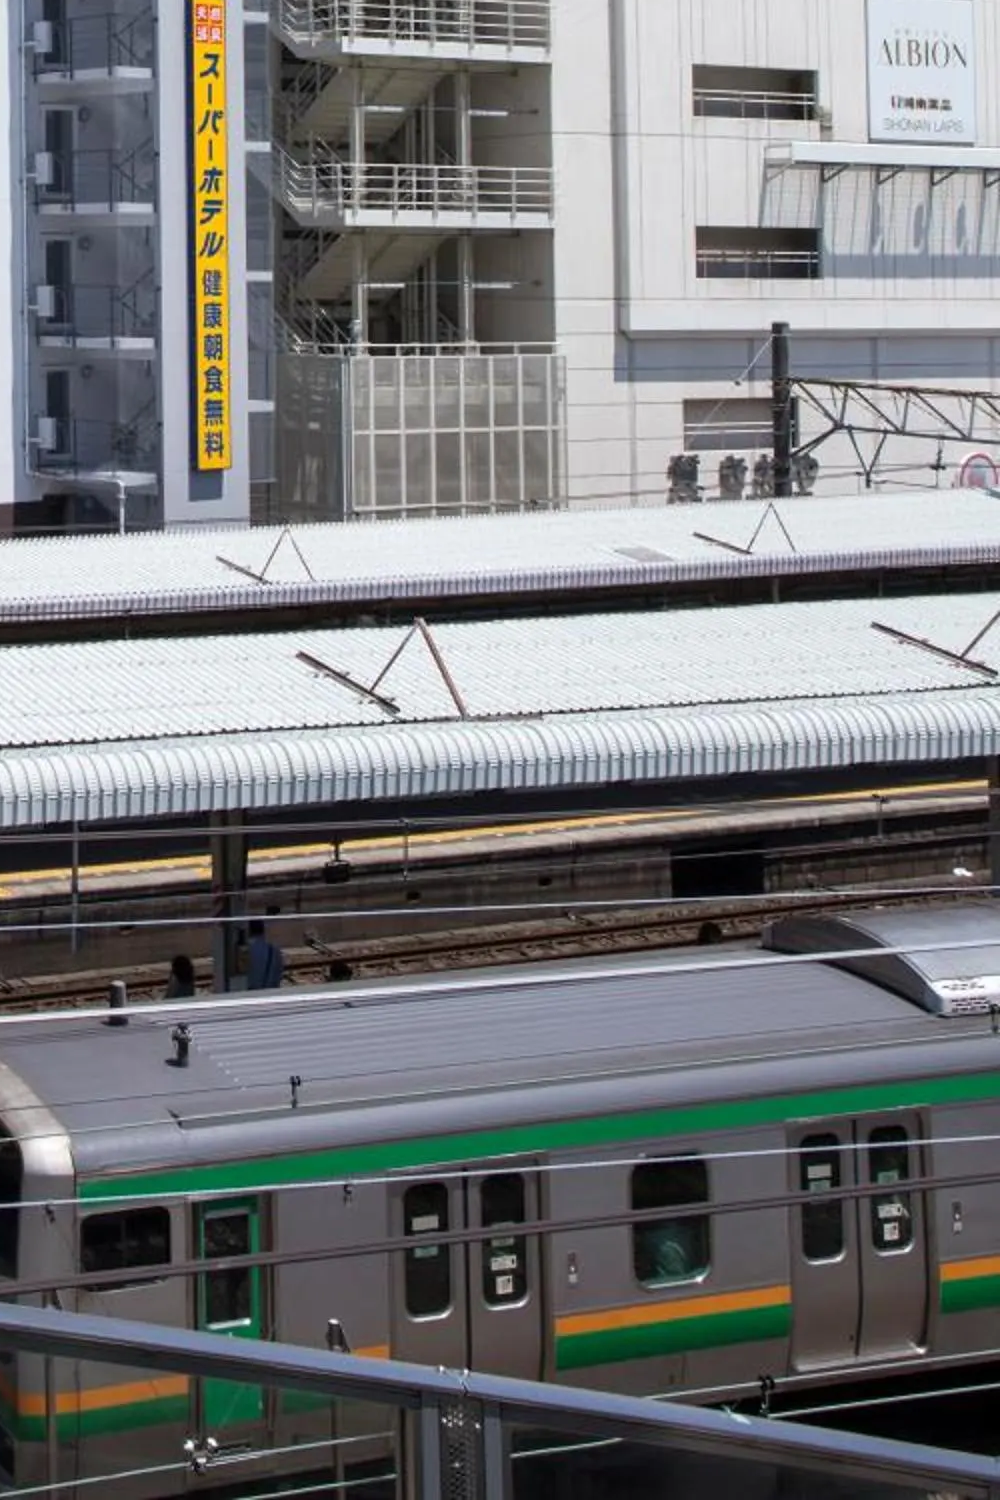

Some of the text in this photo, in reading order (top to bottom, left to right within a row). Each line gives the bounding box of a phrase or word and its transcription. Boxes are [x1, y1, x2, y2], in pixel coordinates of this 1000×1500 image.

[879, 38, 967, 68] ALBION
[198, 52, 225, 459] スーパーホテル 健康朝食無料
